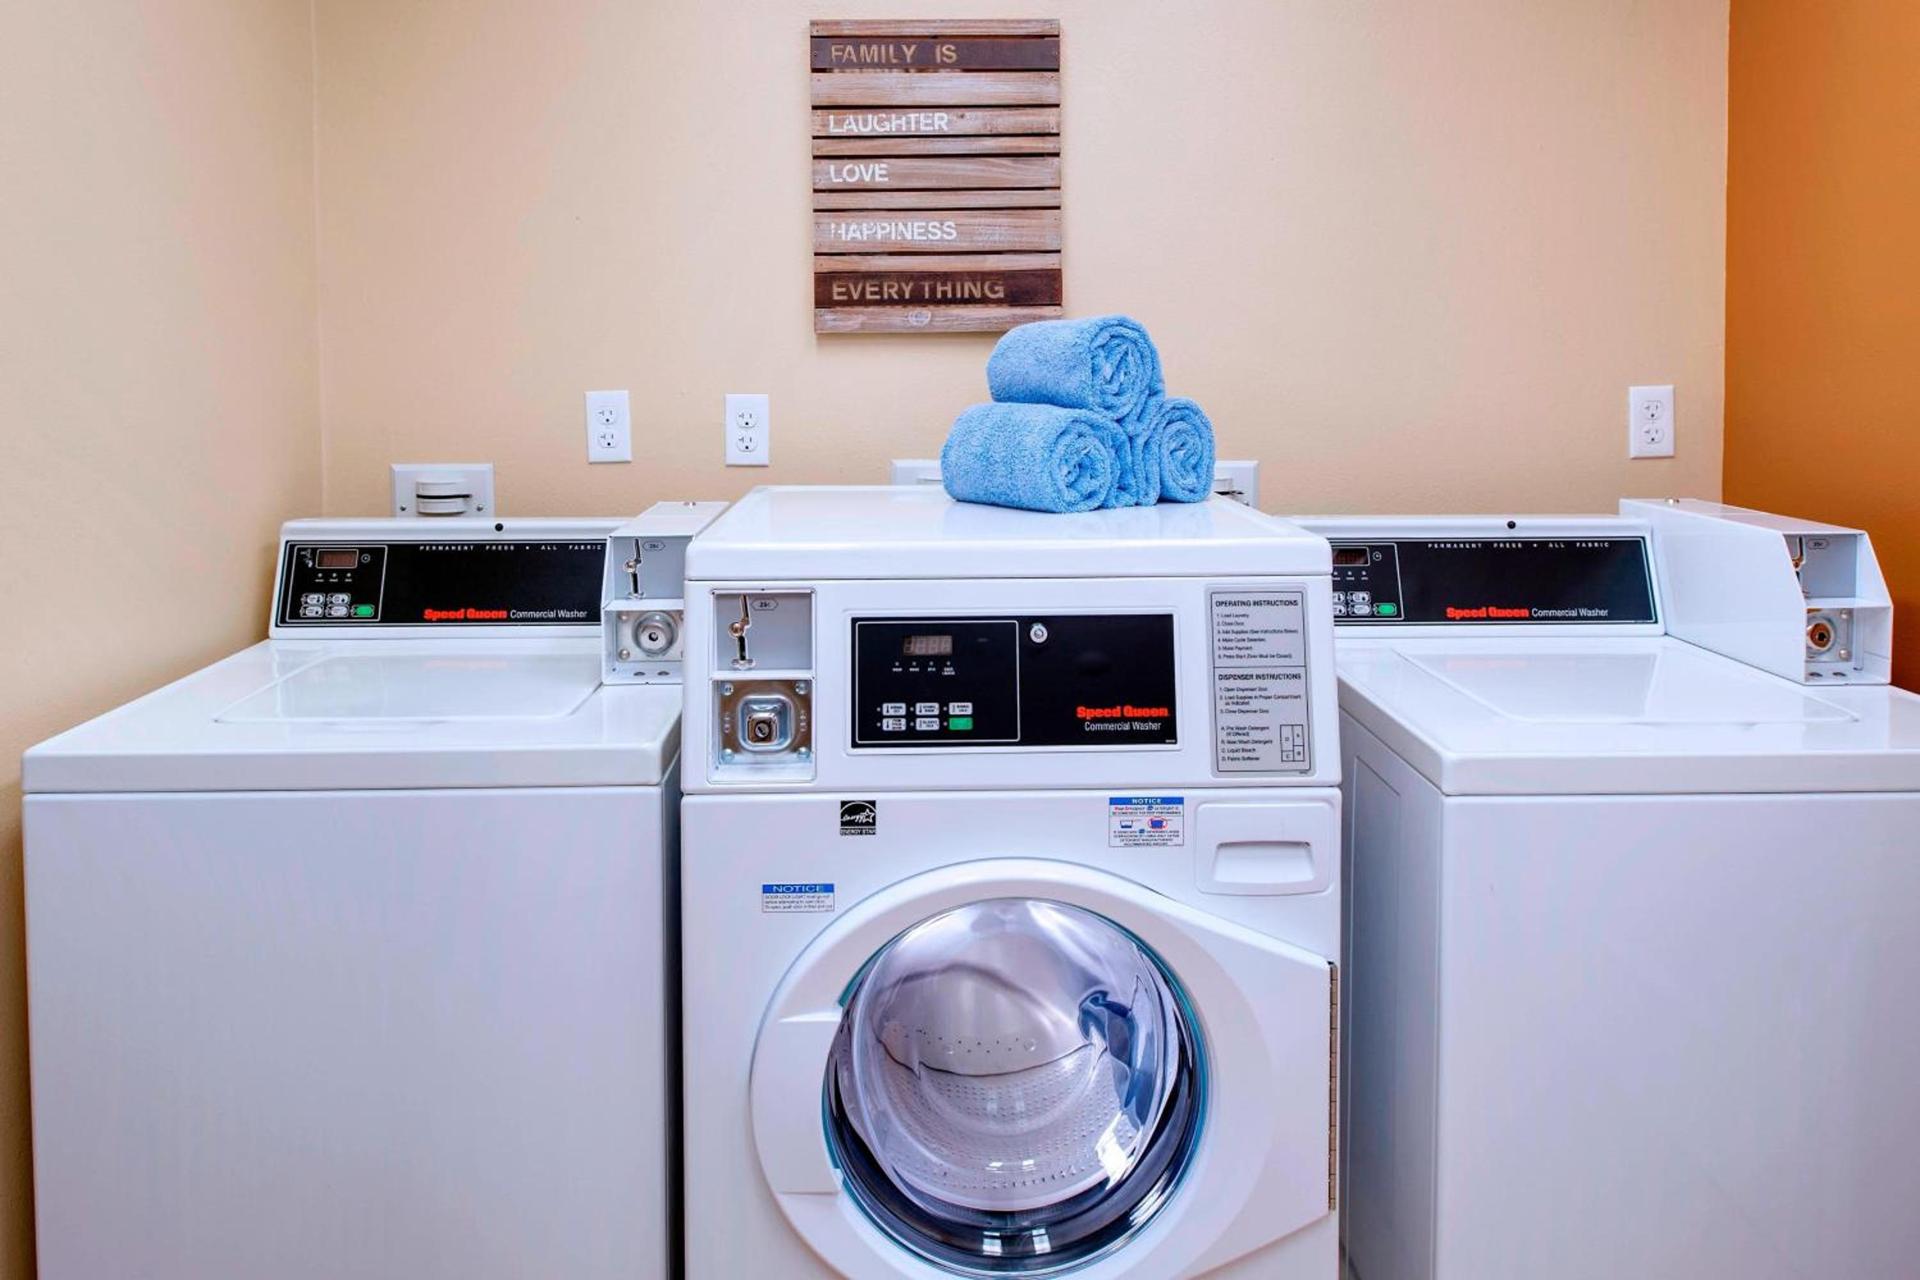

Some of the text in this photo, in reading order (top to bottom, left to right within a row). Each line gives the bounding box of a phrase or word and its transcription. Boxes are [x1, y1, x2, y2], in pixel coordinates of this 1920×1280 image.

[831, 44, 957, 63] FAMILY IS
[829, 113, 949, 133] LAUGHTER
[830, 163, 888, 182] LOVE
[831, 222, 957, 241] HAPPINESS
[424, 608, 587, 620] Speed Queen Commercial Washer
[1446, 606, 1608, 619] Speed Queen Commercial Washer
[1077, 705, 1168, 720] Speed Queen
[1084, 722, 1161, 731] Commercial Washer
